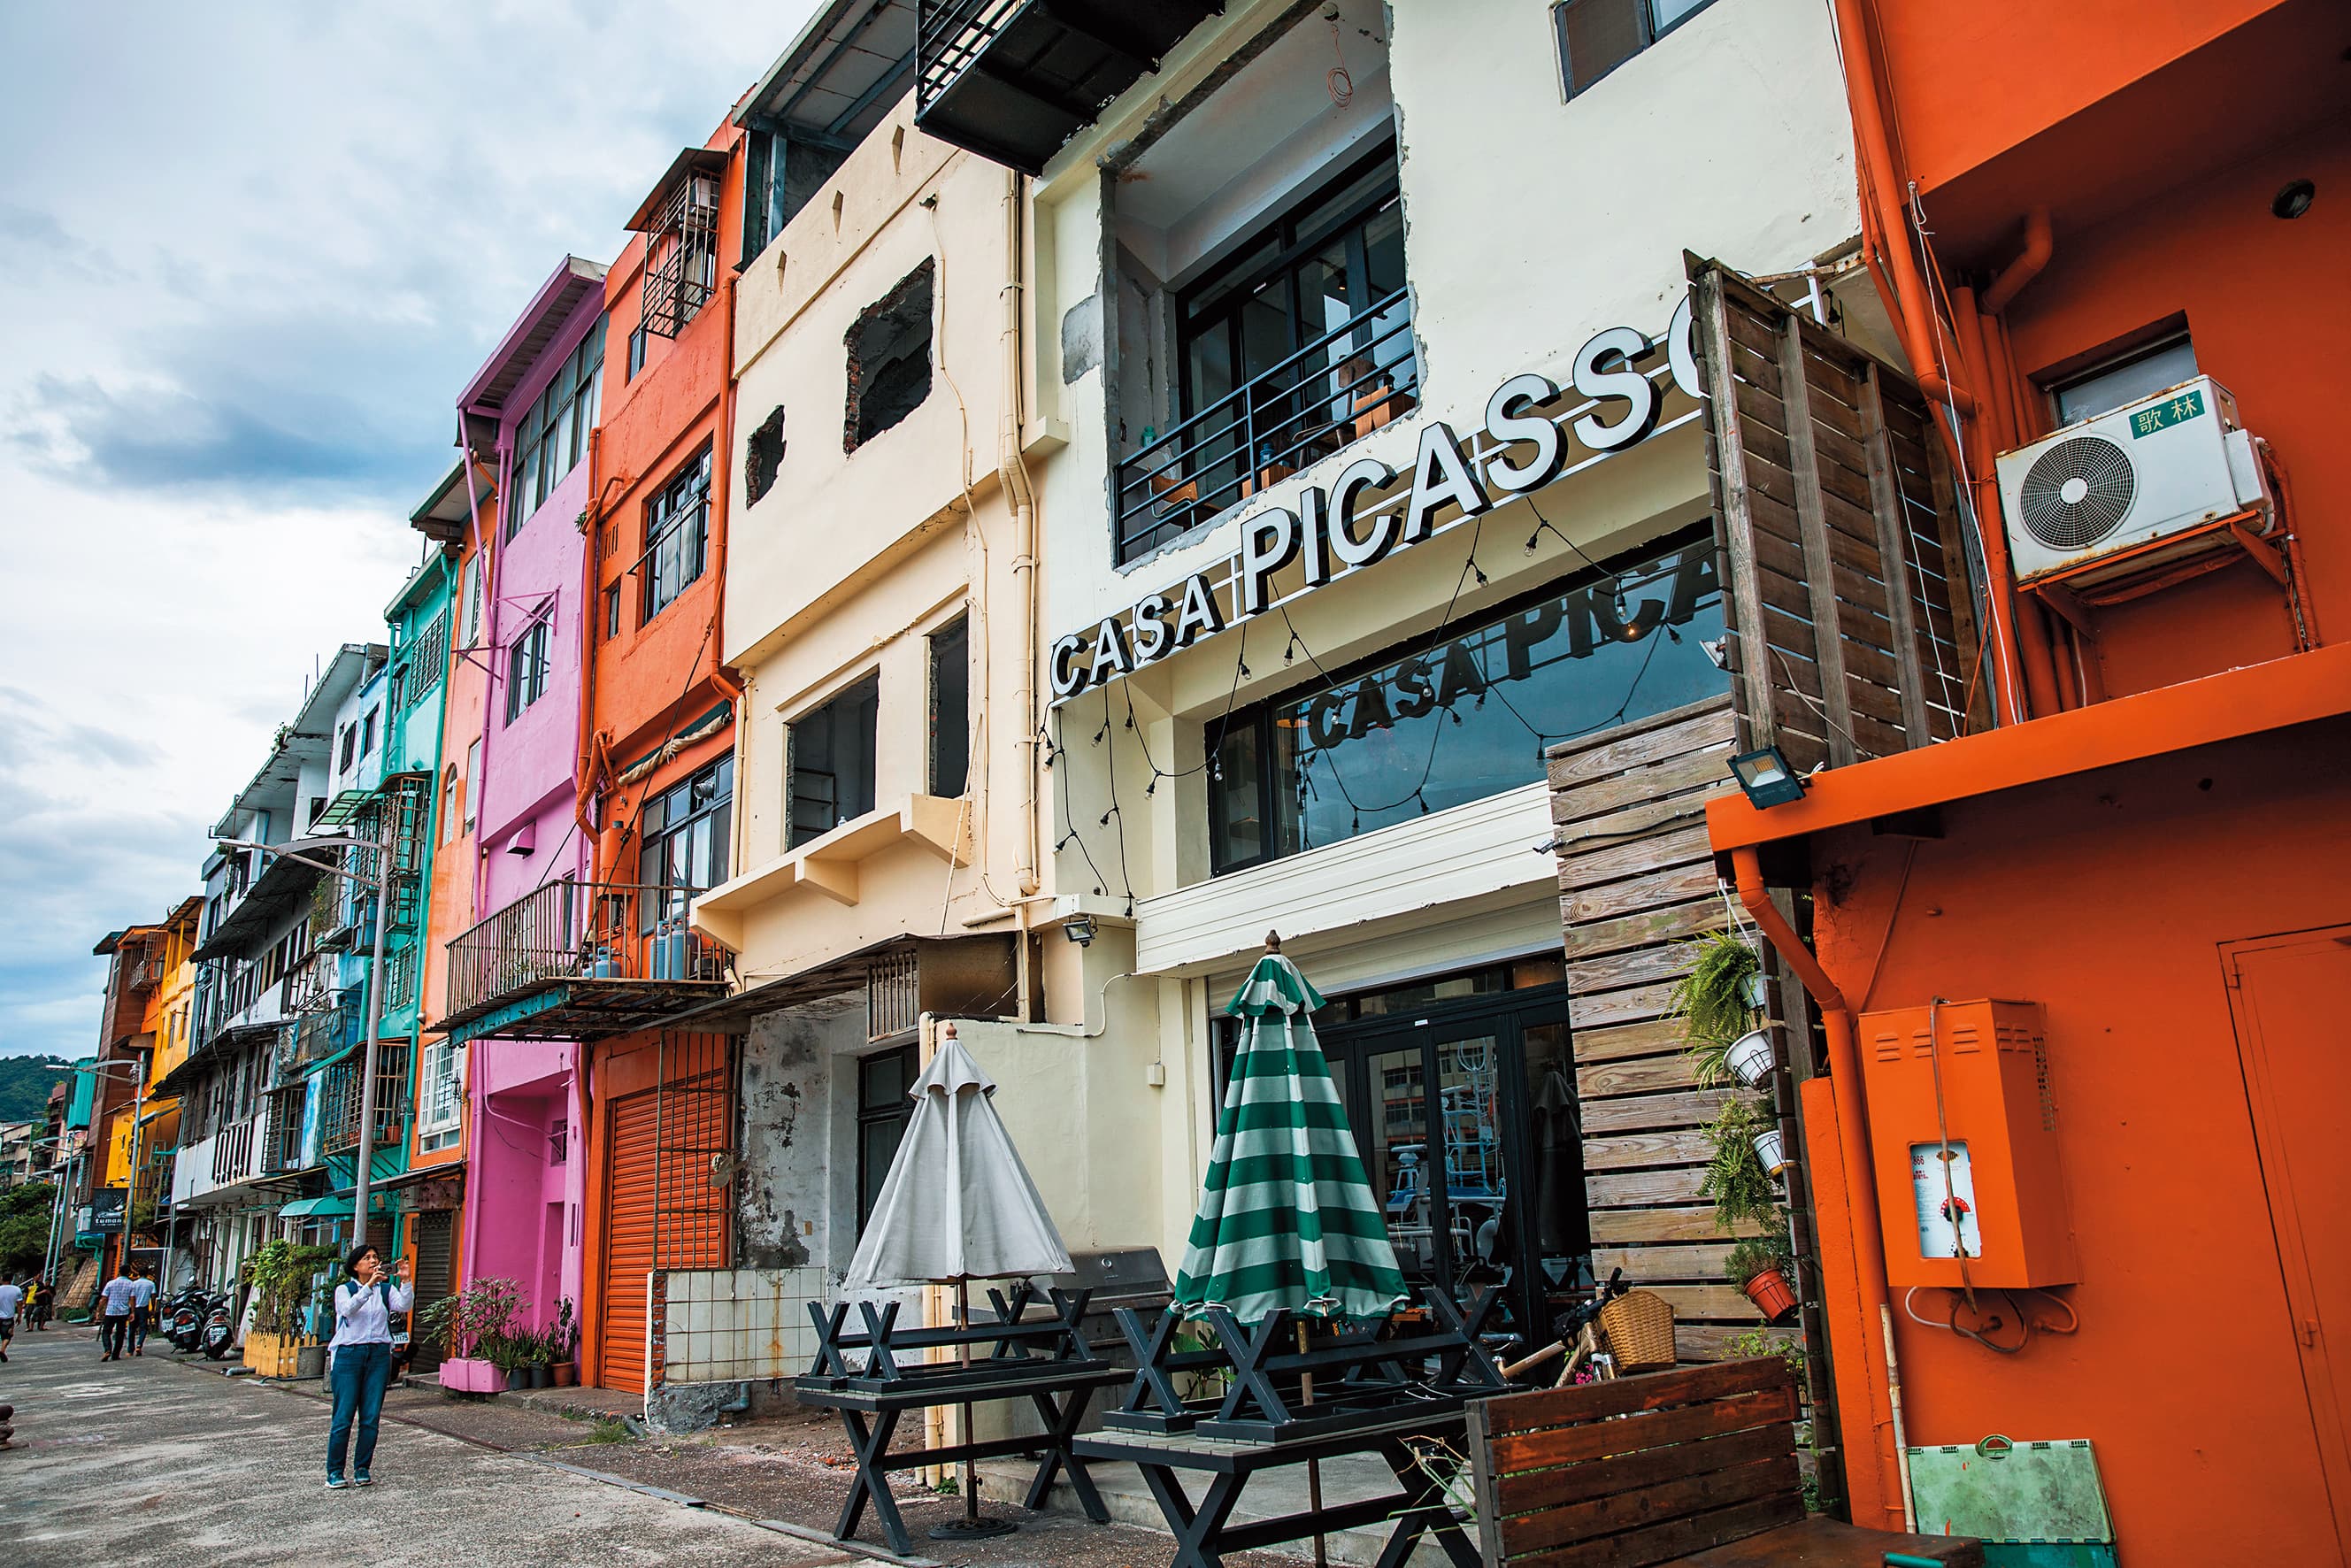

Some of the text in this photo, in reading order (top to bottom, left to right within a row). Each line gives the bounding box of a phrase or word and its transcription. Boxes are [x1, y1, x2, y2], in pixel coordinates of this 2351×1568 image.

[2138, 396, 2198, 433] 歌林
[1050, 573, 1225, 697] CASA
[1308, 642, 1487, 749] CASA
